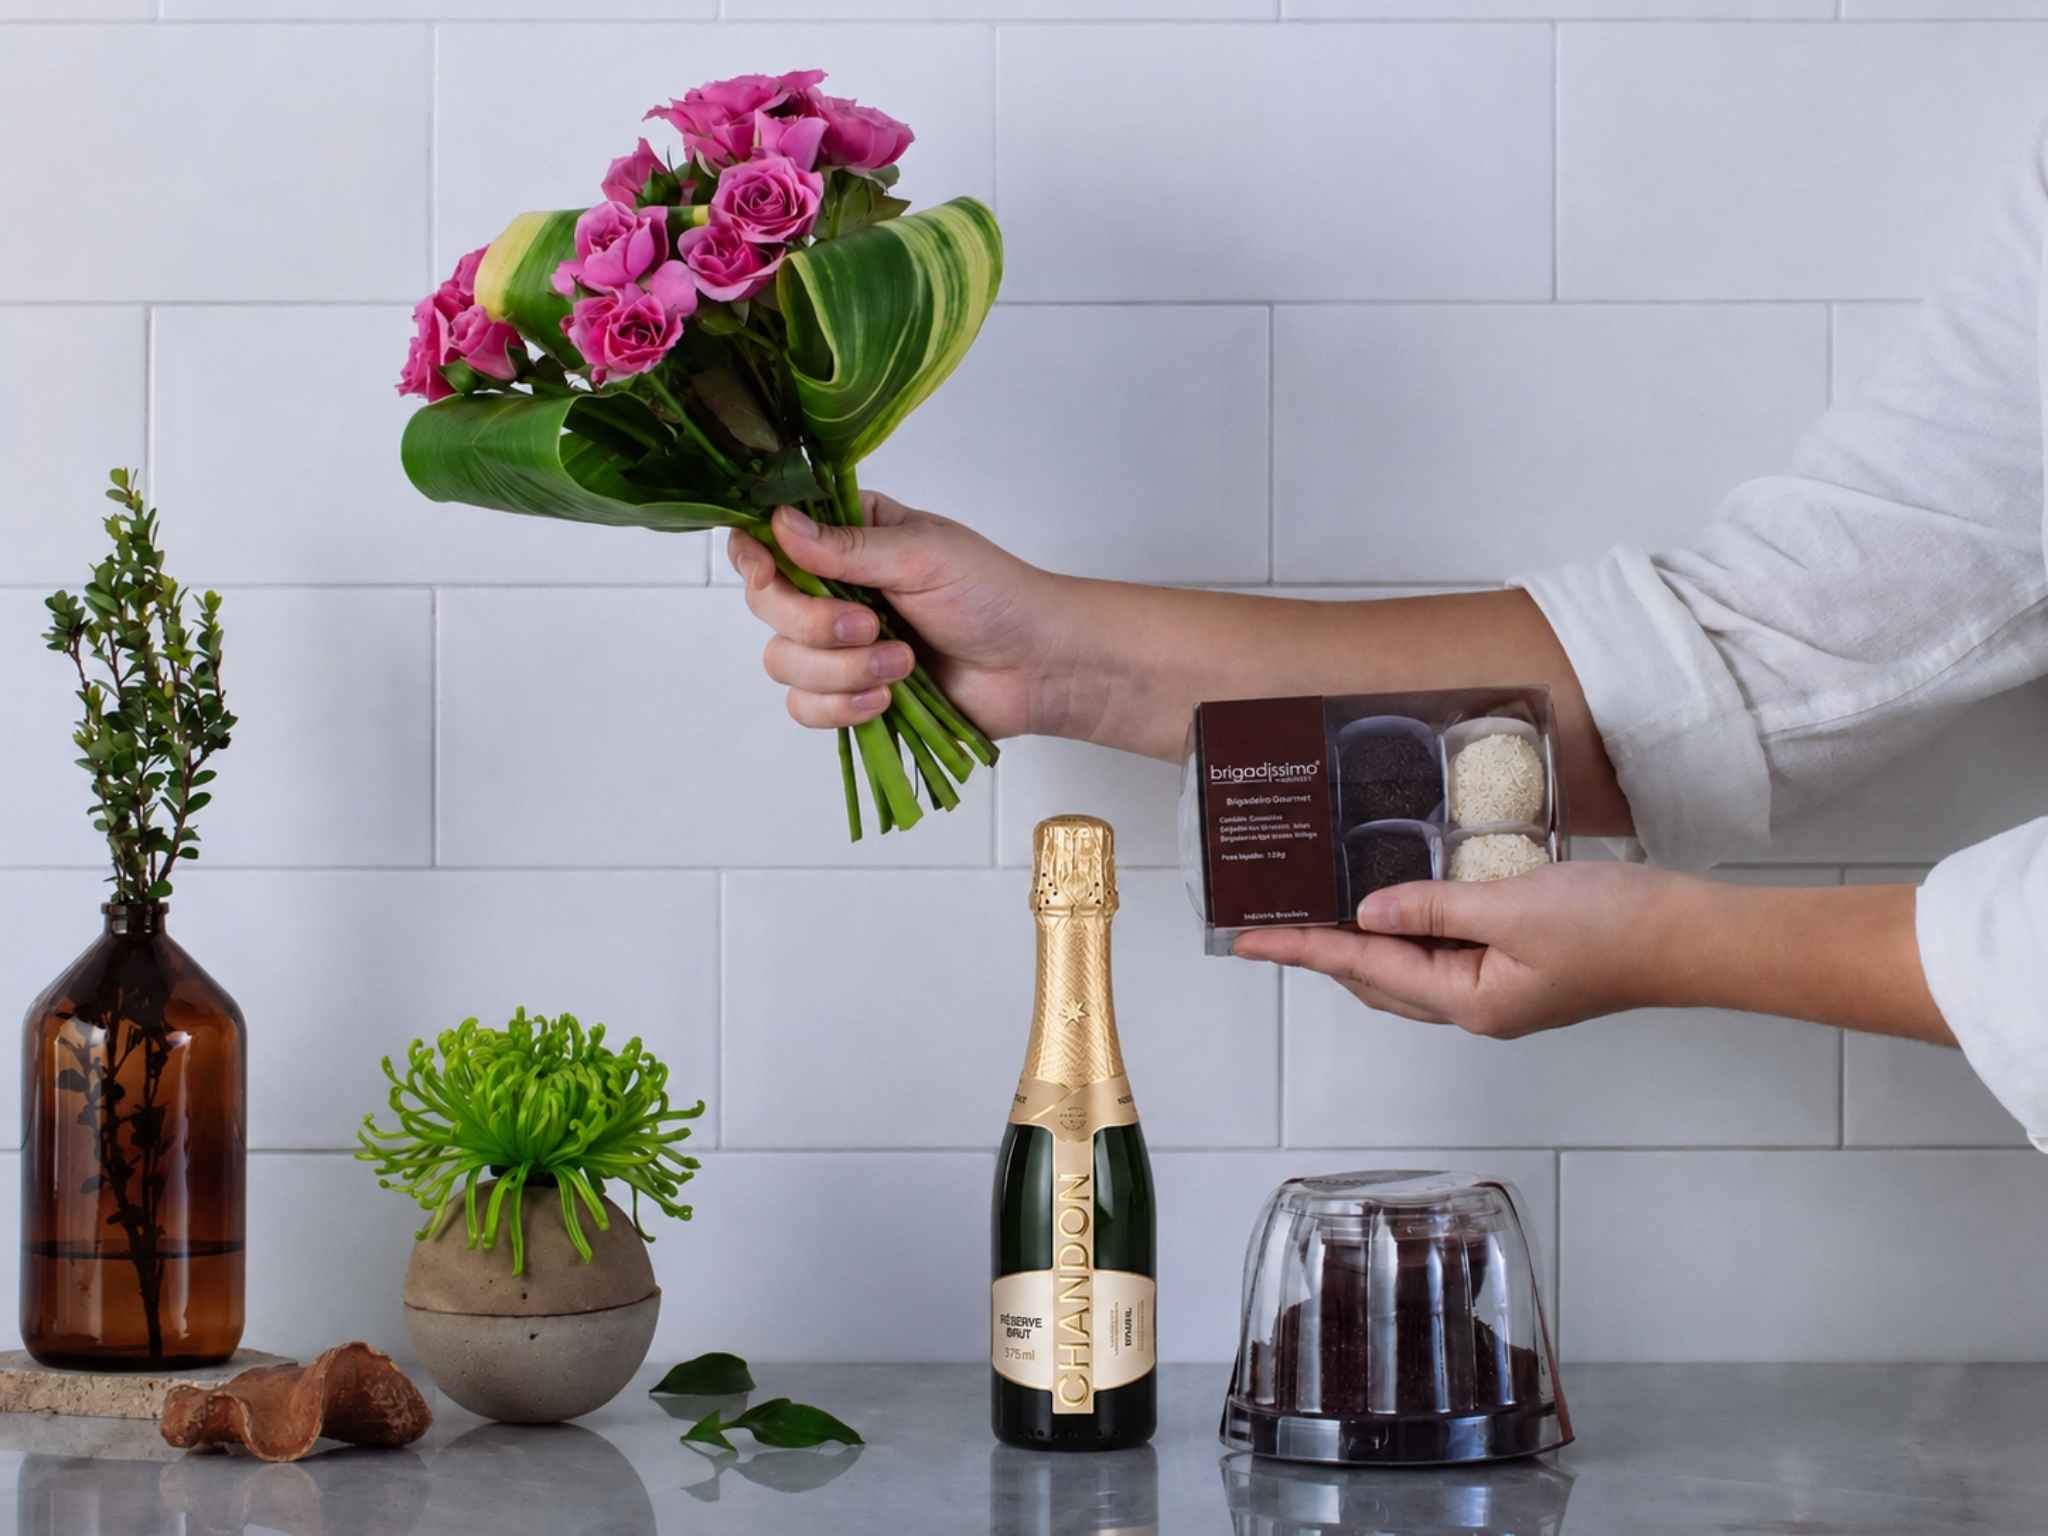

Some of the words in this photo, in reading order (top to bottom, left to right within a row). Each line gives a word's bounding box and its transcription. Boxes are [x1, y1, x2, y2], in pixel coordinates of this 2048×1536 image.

[1210, 761, 1318, 783] brigadissimo
[1226, 796, 1271, 807] Brigadeiro
[1058, 1173, 1090, 1407] CHANDON
[1000, 1312, 1043, 1328] RÉSERVE
[1006, 1327, 1032, 1340] BRUT
